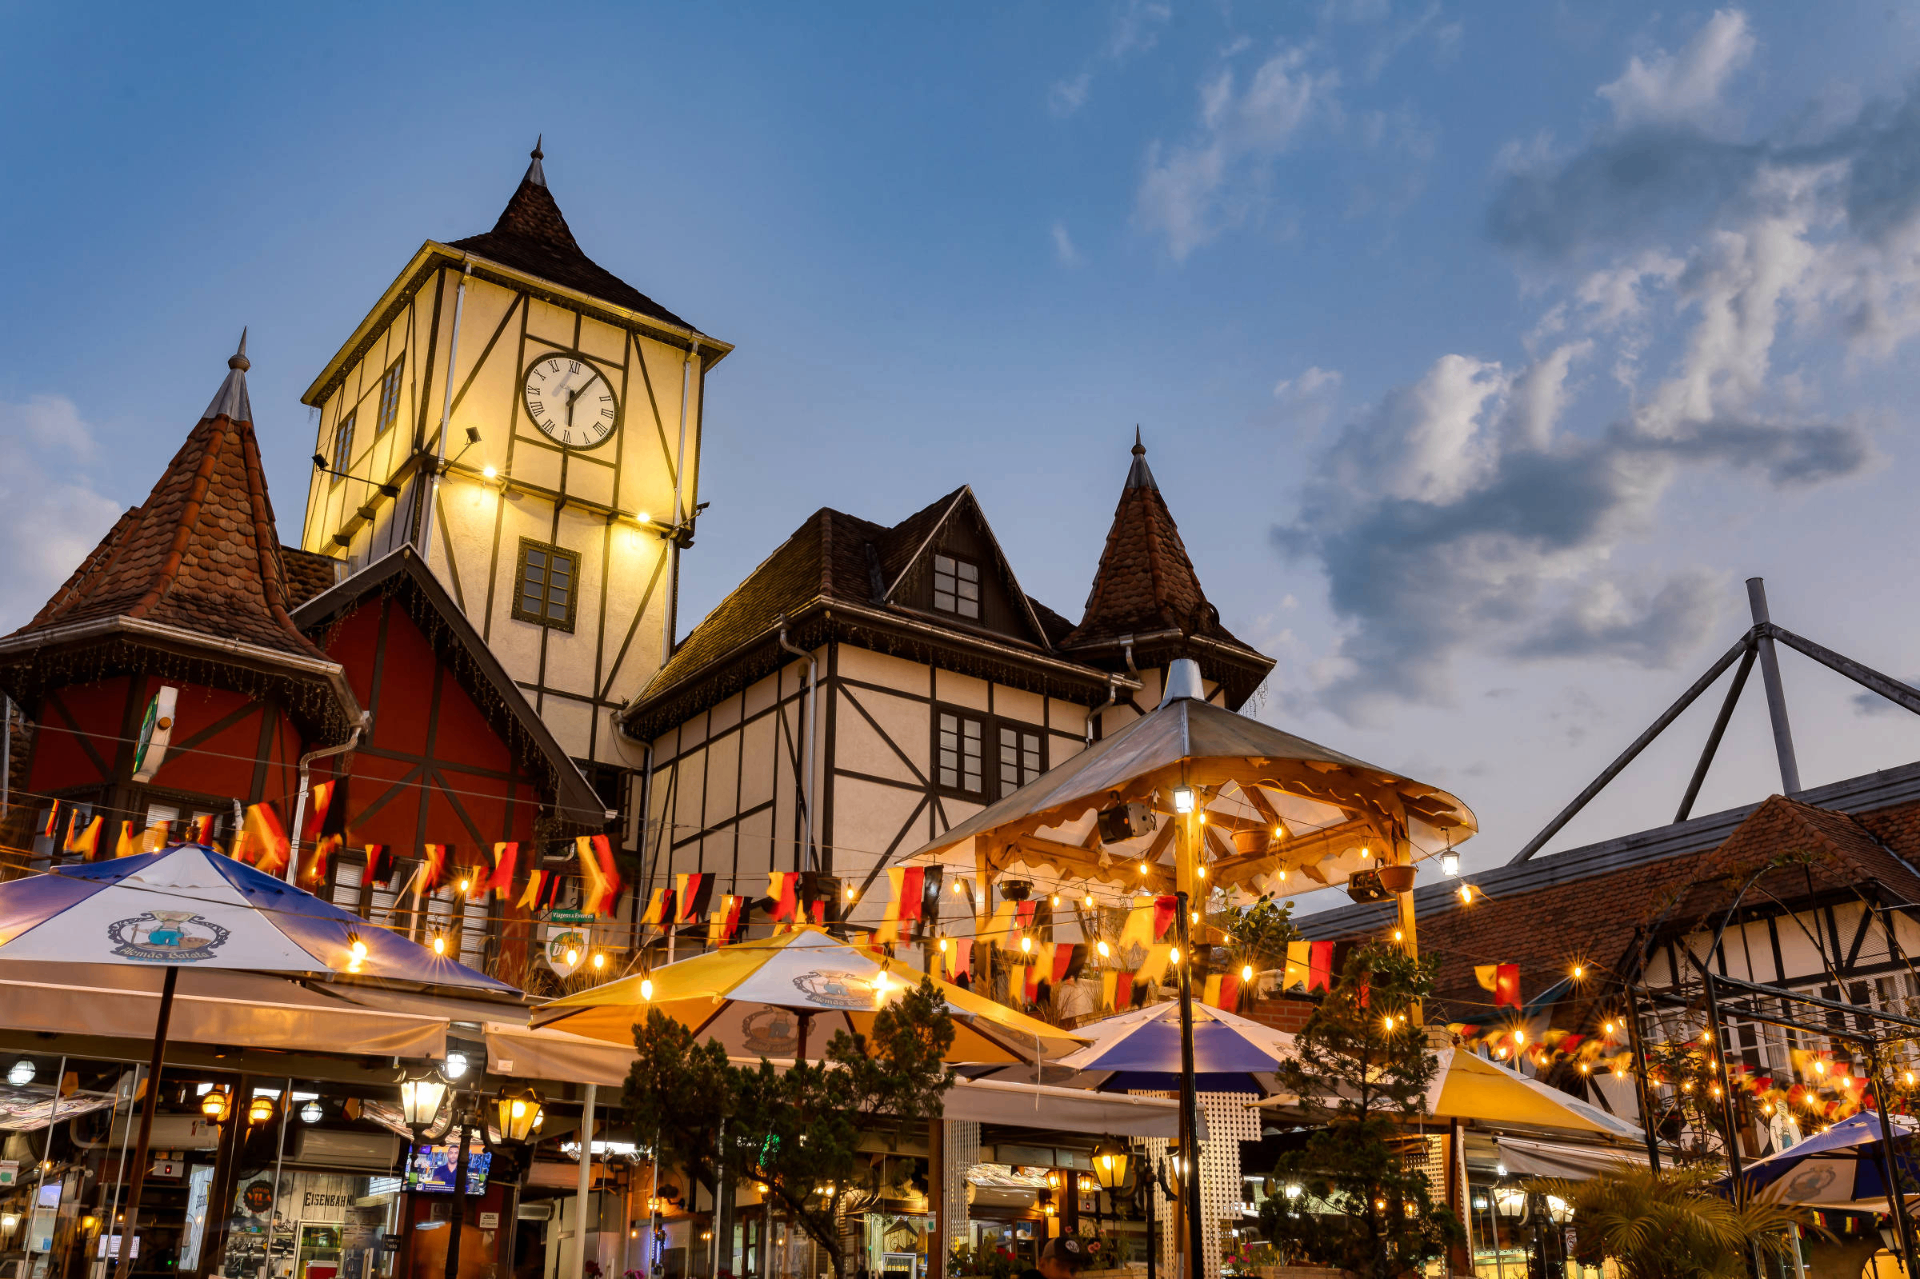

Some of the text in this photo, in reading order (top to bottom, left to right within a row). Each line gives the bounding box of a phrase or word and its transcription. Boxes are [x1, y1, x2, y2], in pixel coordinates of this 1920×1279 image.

[548, 360, 560, 373] XI
[569, 360, 581, 374] XII
[534, 369, 546, 381] X
[528, 385, 540, 395] IX
[530, 401, 545, 417] VIII
[601, 408, 613, 419] III
[542, 419, 556, 434] VII
[562, 429, 571, 444] VI
[583, 431, 591, 444] V
[168, 951, 209, 959] Batata
[305, 1192, 353, 1208] EISENBAHN
